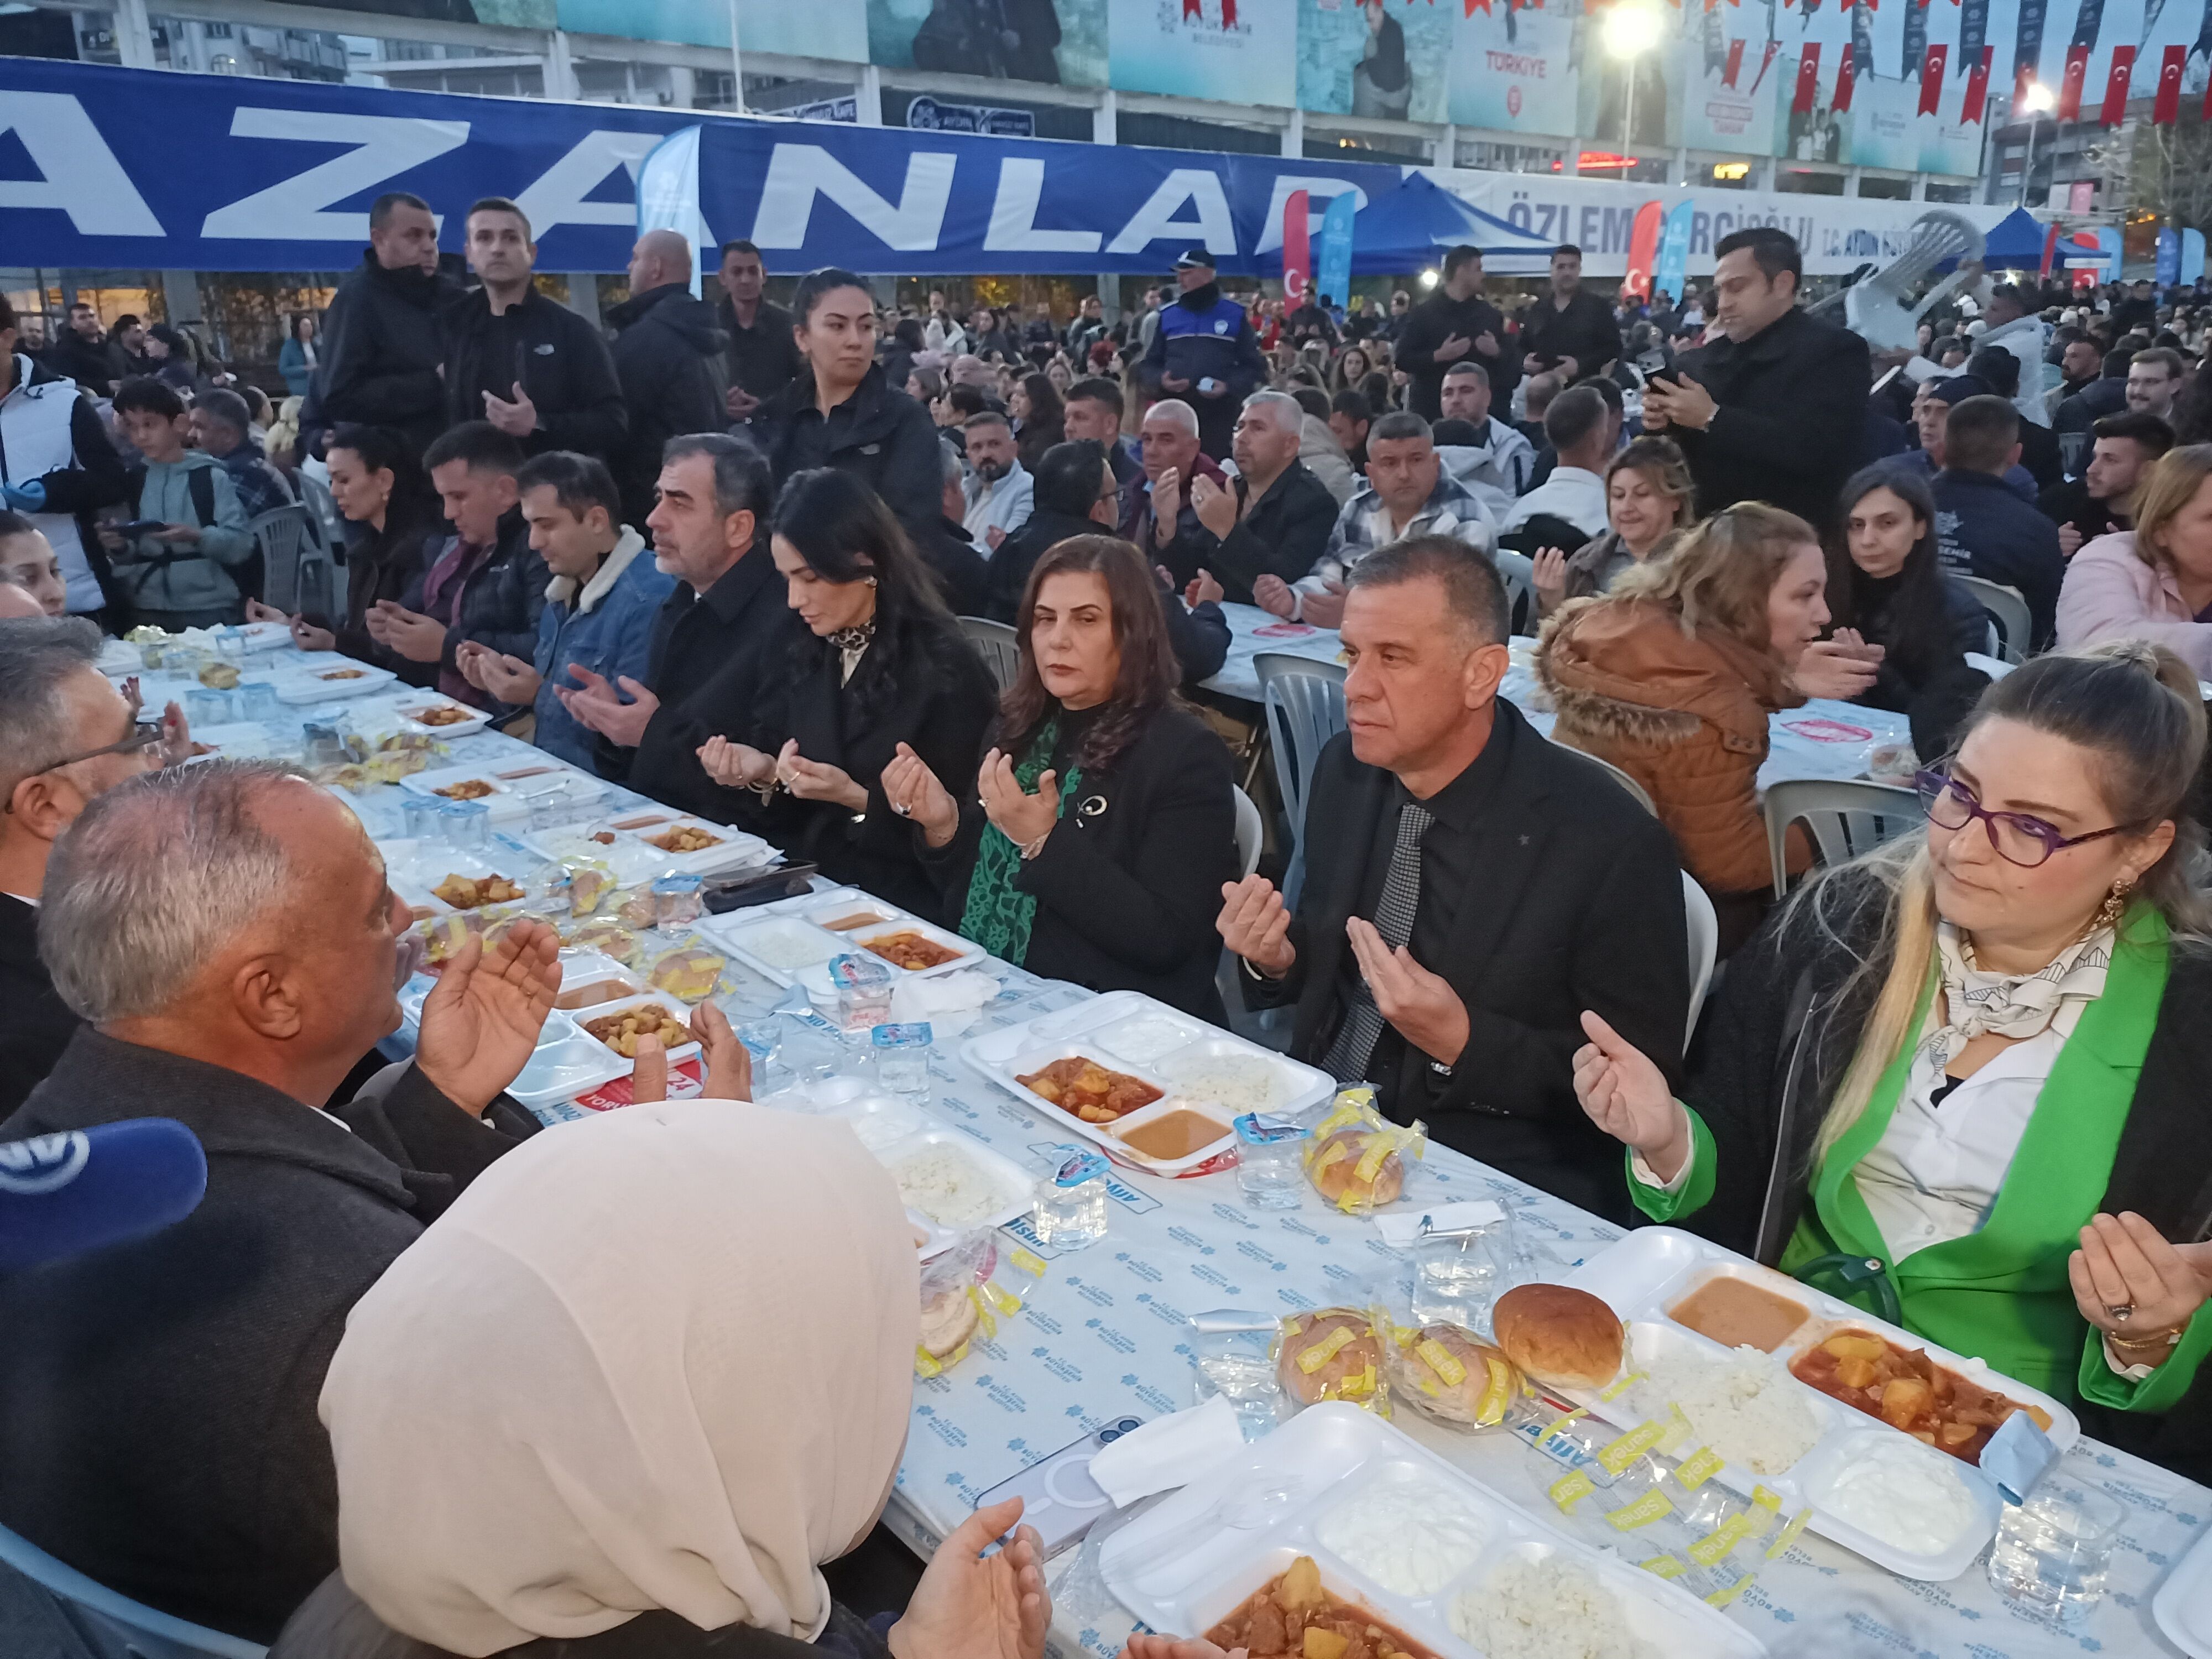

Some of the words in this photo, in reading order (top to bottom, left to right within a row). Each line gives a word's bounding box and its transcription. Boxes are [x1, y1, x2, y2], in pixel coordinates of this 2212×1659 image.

[1604, 1428, 1653, 1466] sanek
[1611, 1498, 1660, 1527] sanek
[1694, 1524, 1741, 1561] sanek
